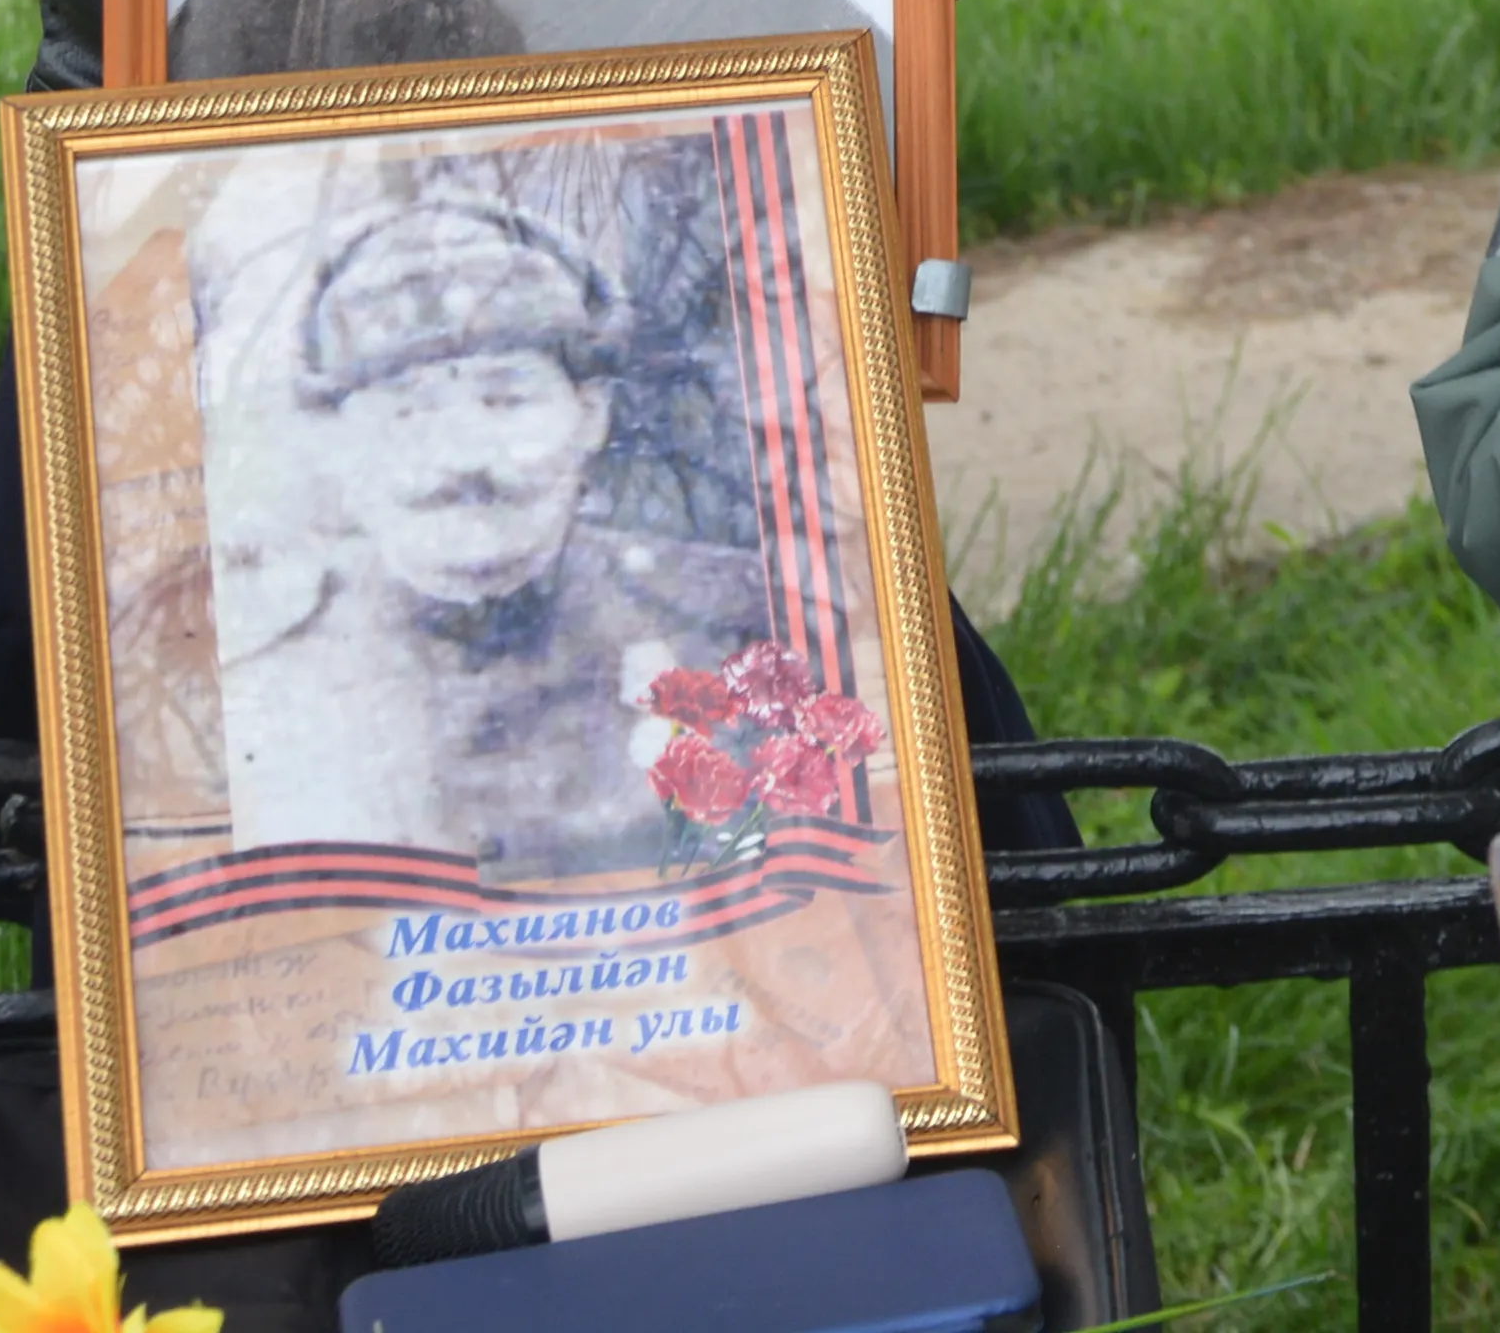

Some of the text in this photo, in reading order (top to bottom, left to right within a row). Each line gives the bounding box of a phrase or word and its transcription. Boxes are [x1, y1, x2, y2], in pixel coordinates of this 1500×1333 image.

[385, 898, 681, 958] Махиянов
[391, 950, 689, 1013] Фазылйән
[347, 1015, 613, 1076] Махийән
[630, 1001, 741, 1054] улы
